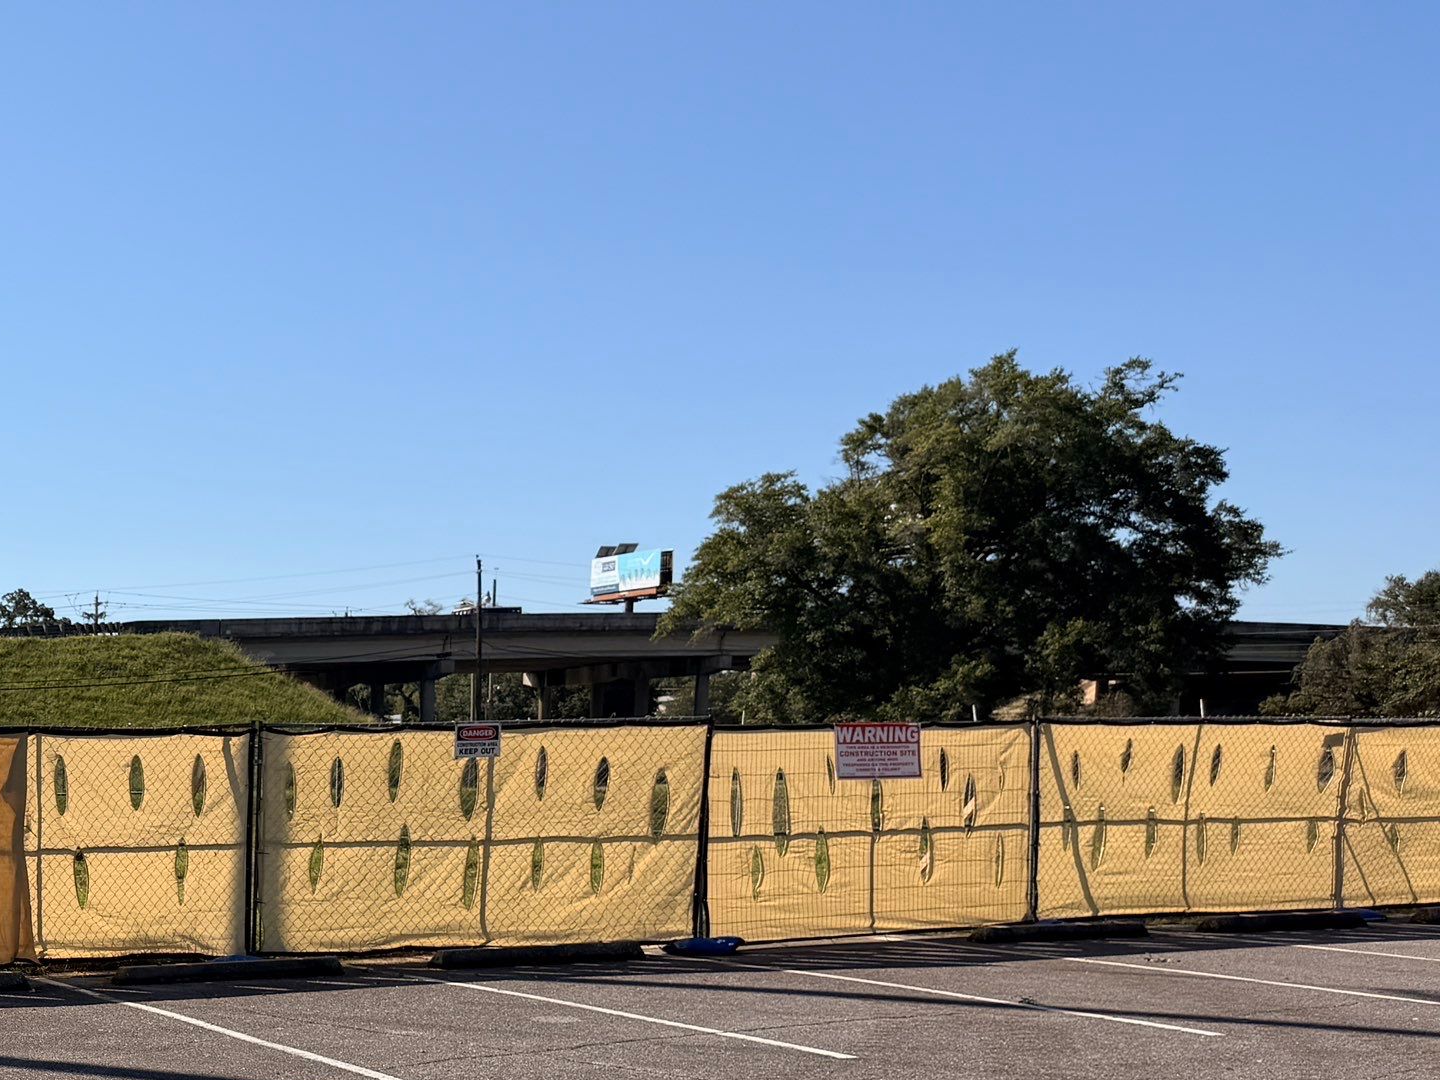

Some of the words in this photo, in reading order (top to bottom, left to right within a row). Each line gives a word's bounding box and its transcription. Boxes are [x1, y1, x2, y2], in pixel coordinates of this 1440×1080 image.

[837, 726, 918, 743] WARNING
[480, 747, 495, 755] OUT
[840, 750, 898, 758] CONSTRUCTION
